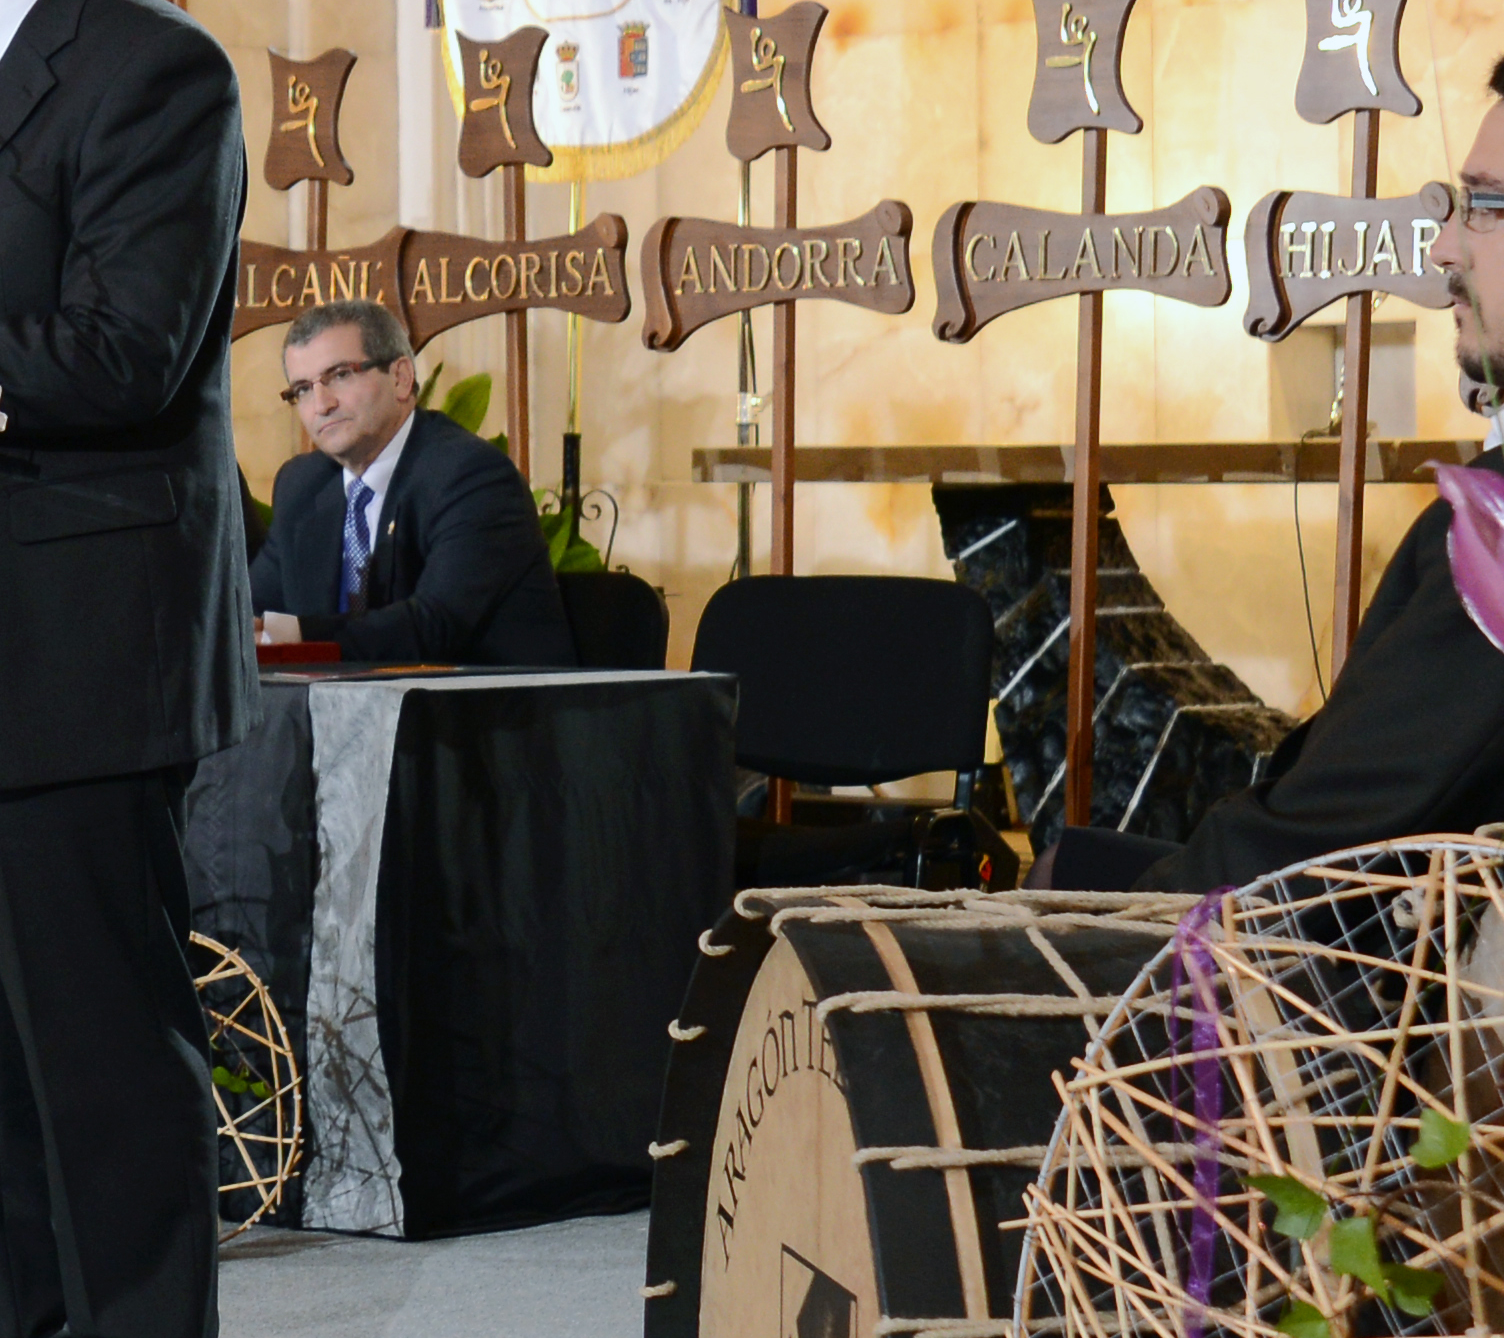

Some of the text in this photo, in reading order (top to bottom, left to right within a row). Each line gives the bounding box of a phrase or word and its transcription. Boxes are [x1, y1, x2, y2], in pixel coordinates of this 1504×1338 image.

[409, 247, 616, 304] ALCORISA
[674, 235, 903, 295] ANDORRA
[965, 223, 1217, 283] CALANDA
[1280, 218, 1447, 280] HIJAR
[235, 254, 385, 308] LCAÑI
[716, 1009, 799, 1273] ARAGÓN
